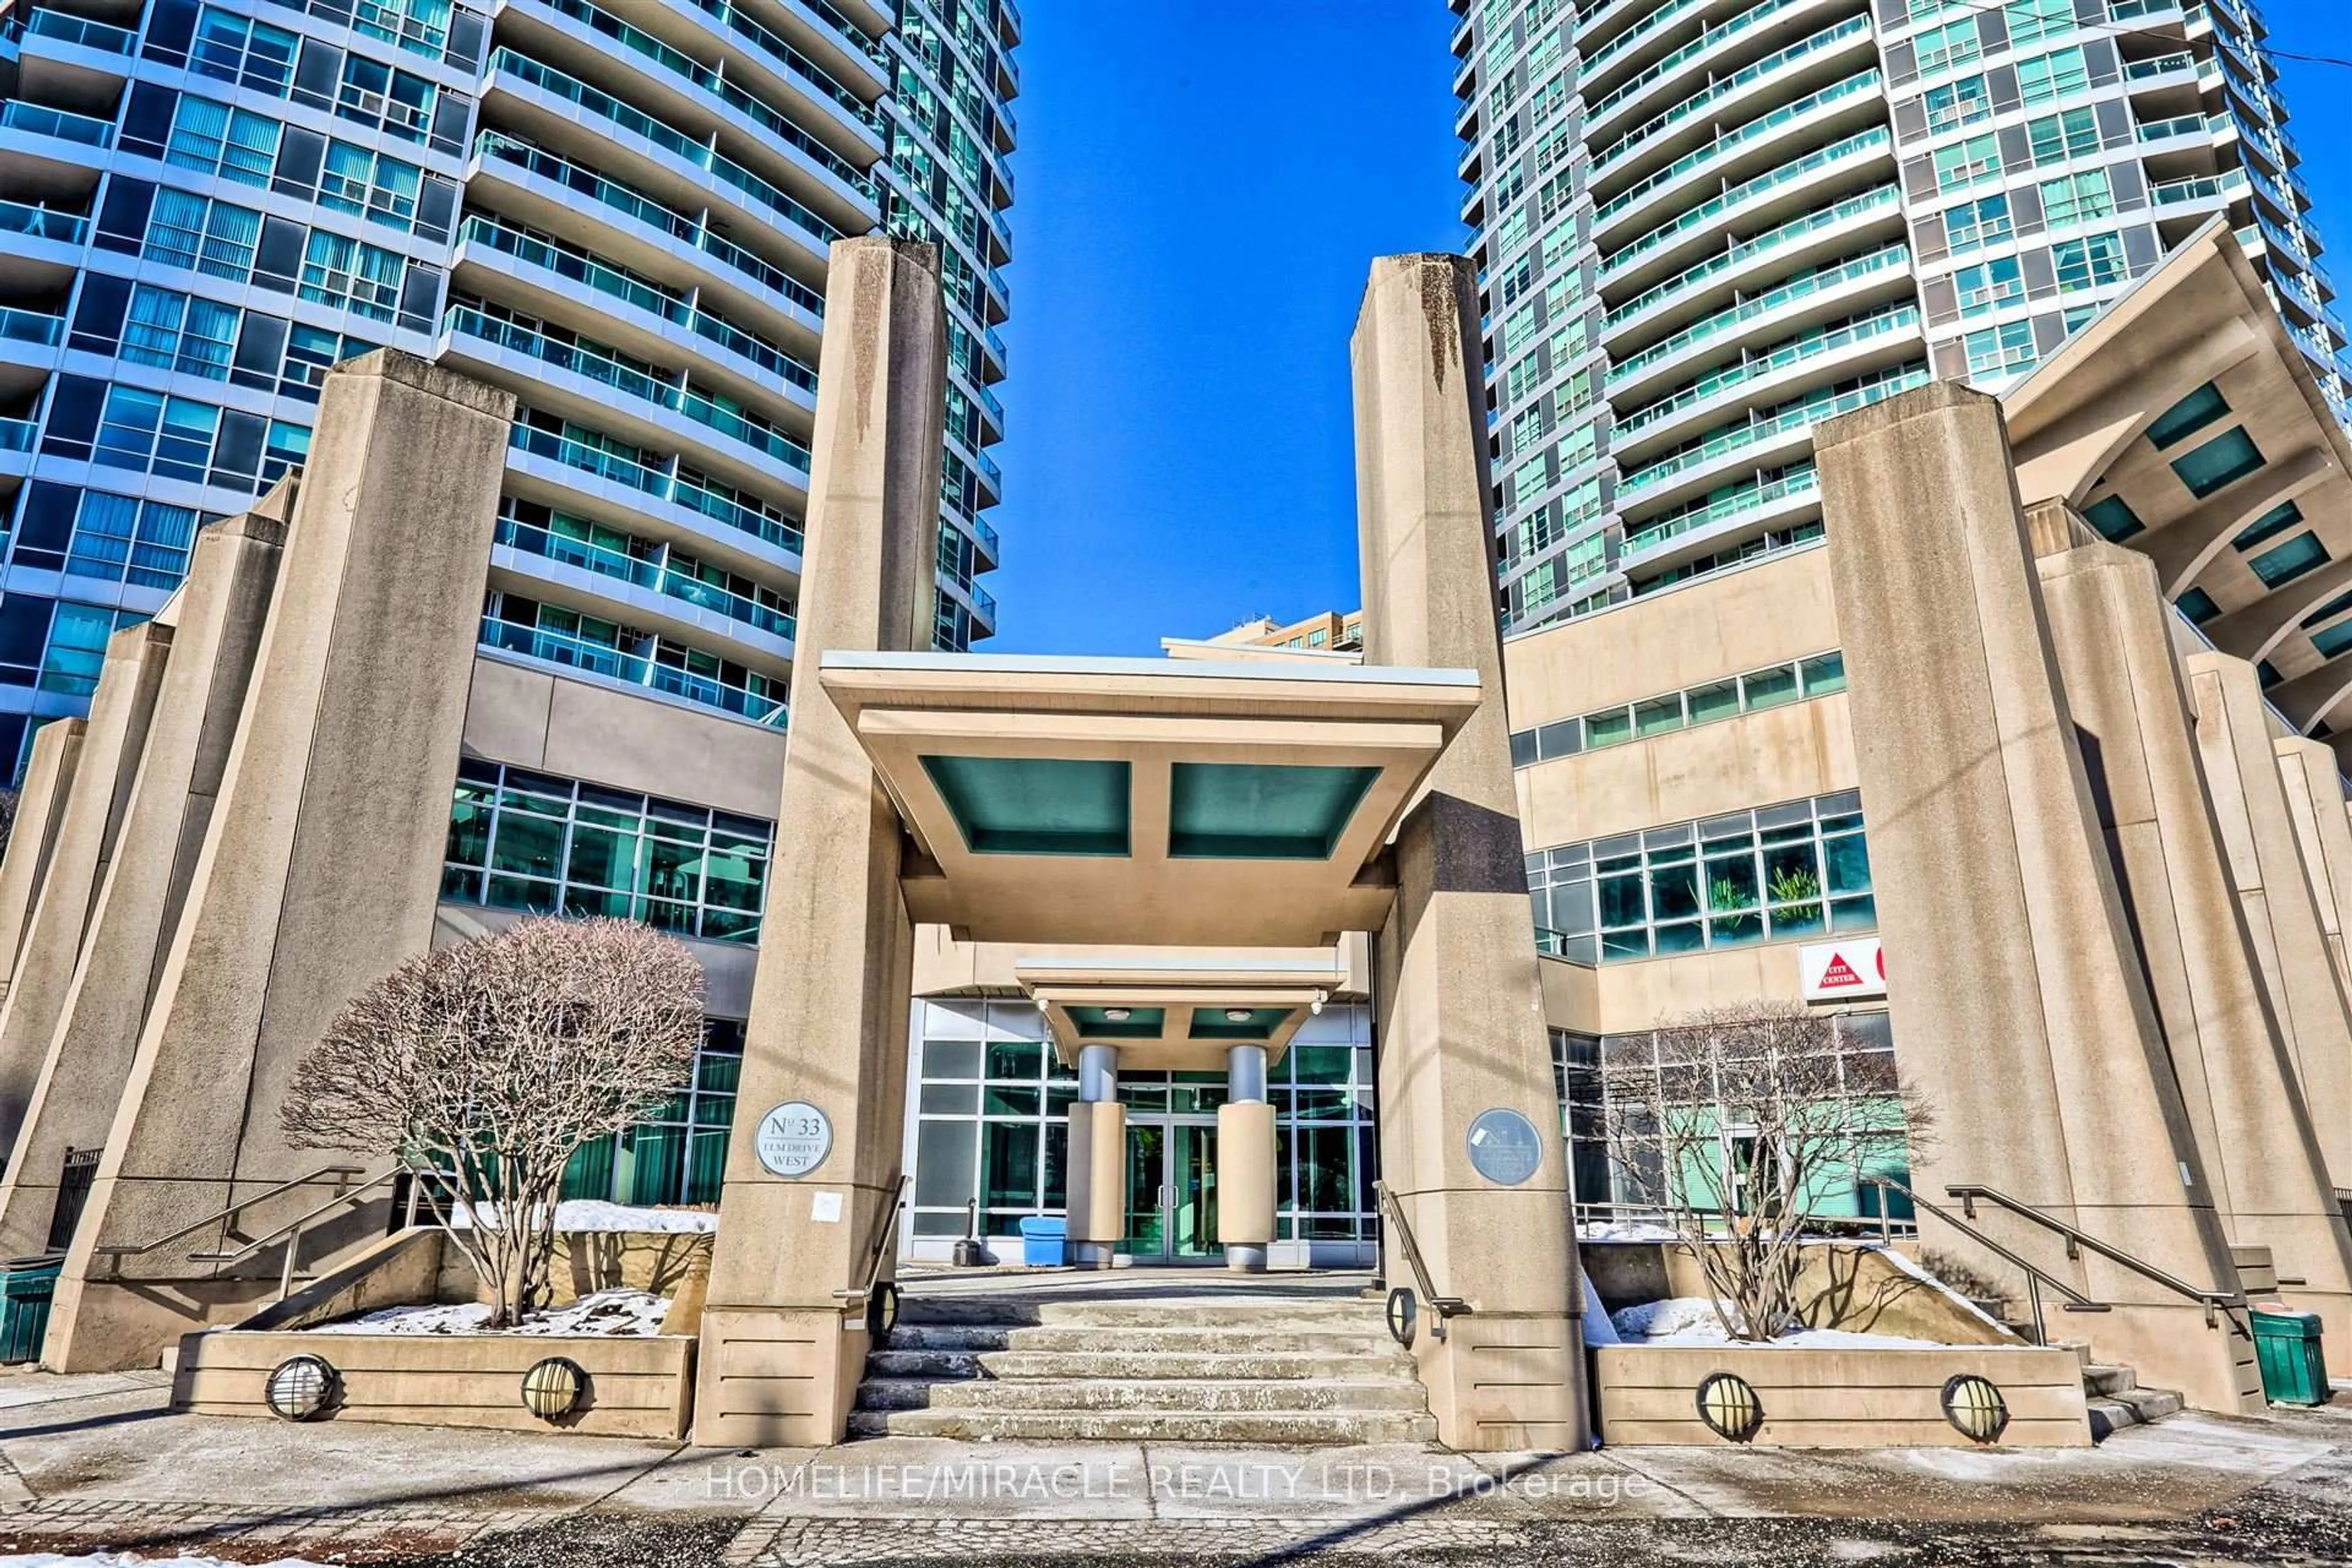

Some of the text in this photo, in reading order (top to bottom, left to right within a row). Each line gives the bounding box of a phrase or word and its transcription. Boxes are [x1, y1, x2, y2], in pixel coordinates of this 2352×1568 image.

[797, 1118, 821, 1136] 33
[764, 1143, 822, 1153] ELM DRIVE
[773, 1155, 810, 1166] WEST
